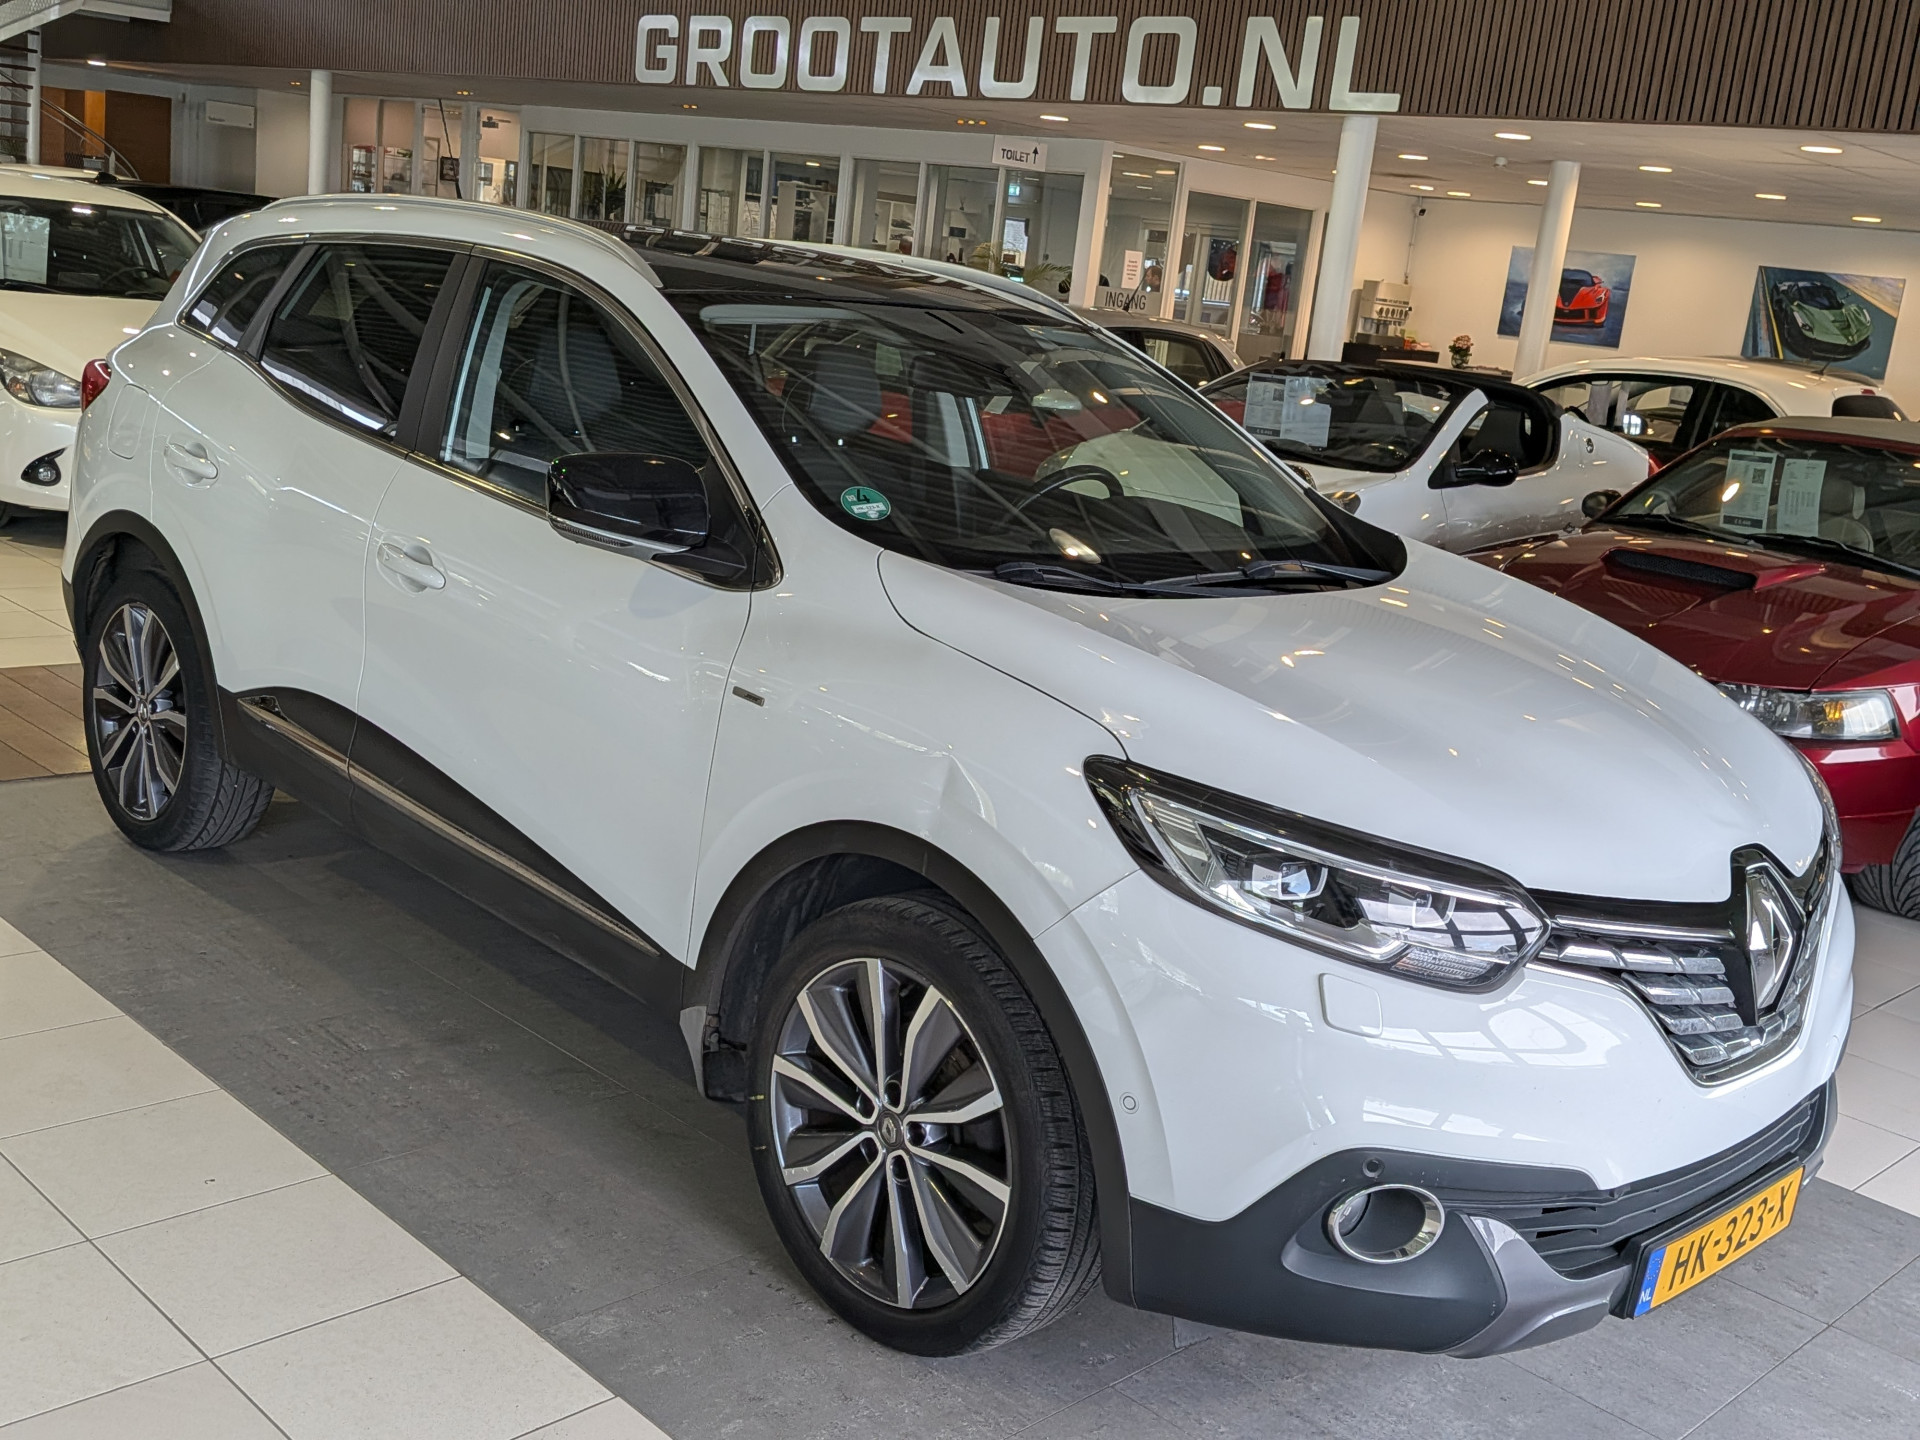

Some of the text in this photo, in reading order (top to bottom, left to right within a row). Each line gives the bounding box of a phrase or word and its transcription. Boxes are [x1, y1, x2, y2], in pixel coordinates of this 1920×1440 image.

[635, 14, 1401, 112] GROOTAUTO.NL
[1001, 148, 1030, 163] TOILET
[1104, 291, 1147, 311] INGANG
[856, 489, 870, 503] 4
[1668, 1180, 1794, 1292] HK-323-X
[1639, 1287, 1652, 1305] NL
